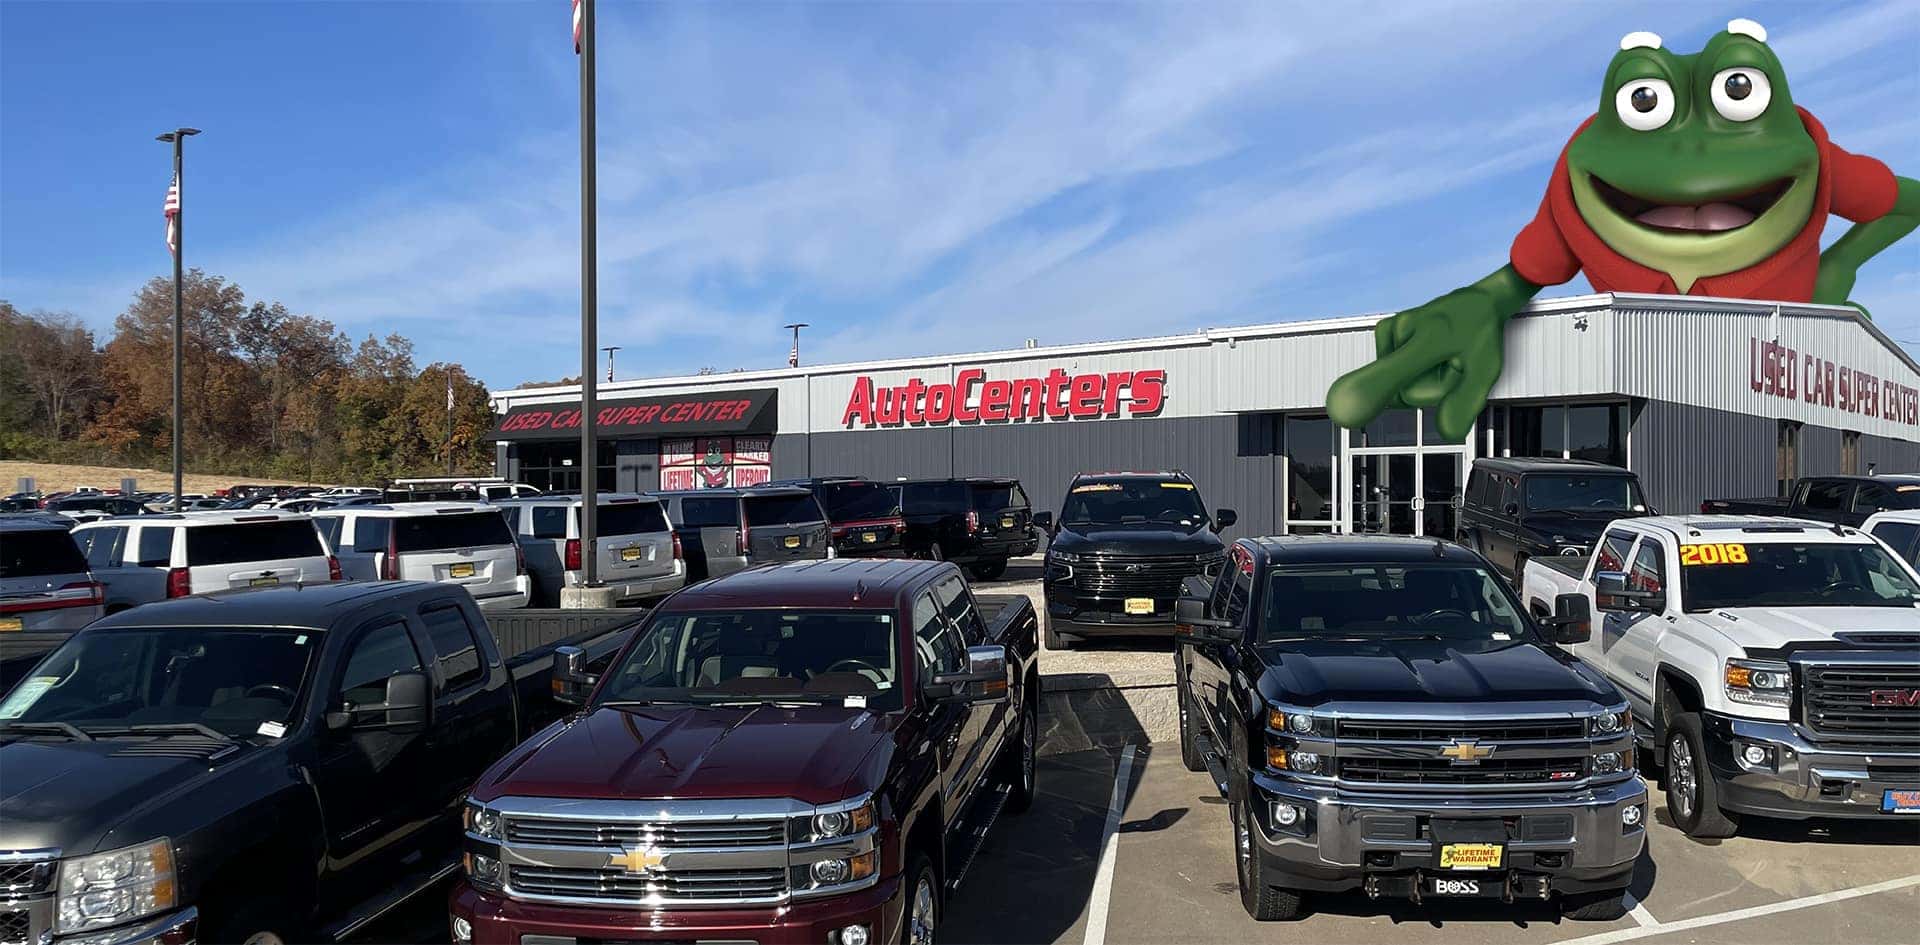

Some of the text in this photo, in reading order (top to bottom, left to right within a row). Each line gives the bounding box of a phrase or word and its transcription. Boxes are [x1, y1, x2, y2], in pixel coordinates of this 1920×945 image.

[1750, 337, 1919, 426] USED CAR SUPER CENTER
[842, 368, 1167, 427] AutoCenters
[500, 400, 750, 431] USED CA SUPER CENTER
[735, 440, 769, 452] CLEARLY
[663, 468, 694, 490] LIFETIME
[1680, 543, 1749, 566] 2018
[1452, 855, 1499, 863] WARRANTY
[1436, 879, 1479, 893] BOSS
